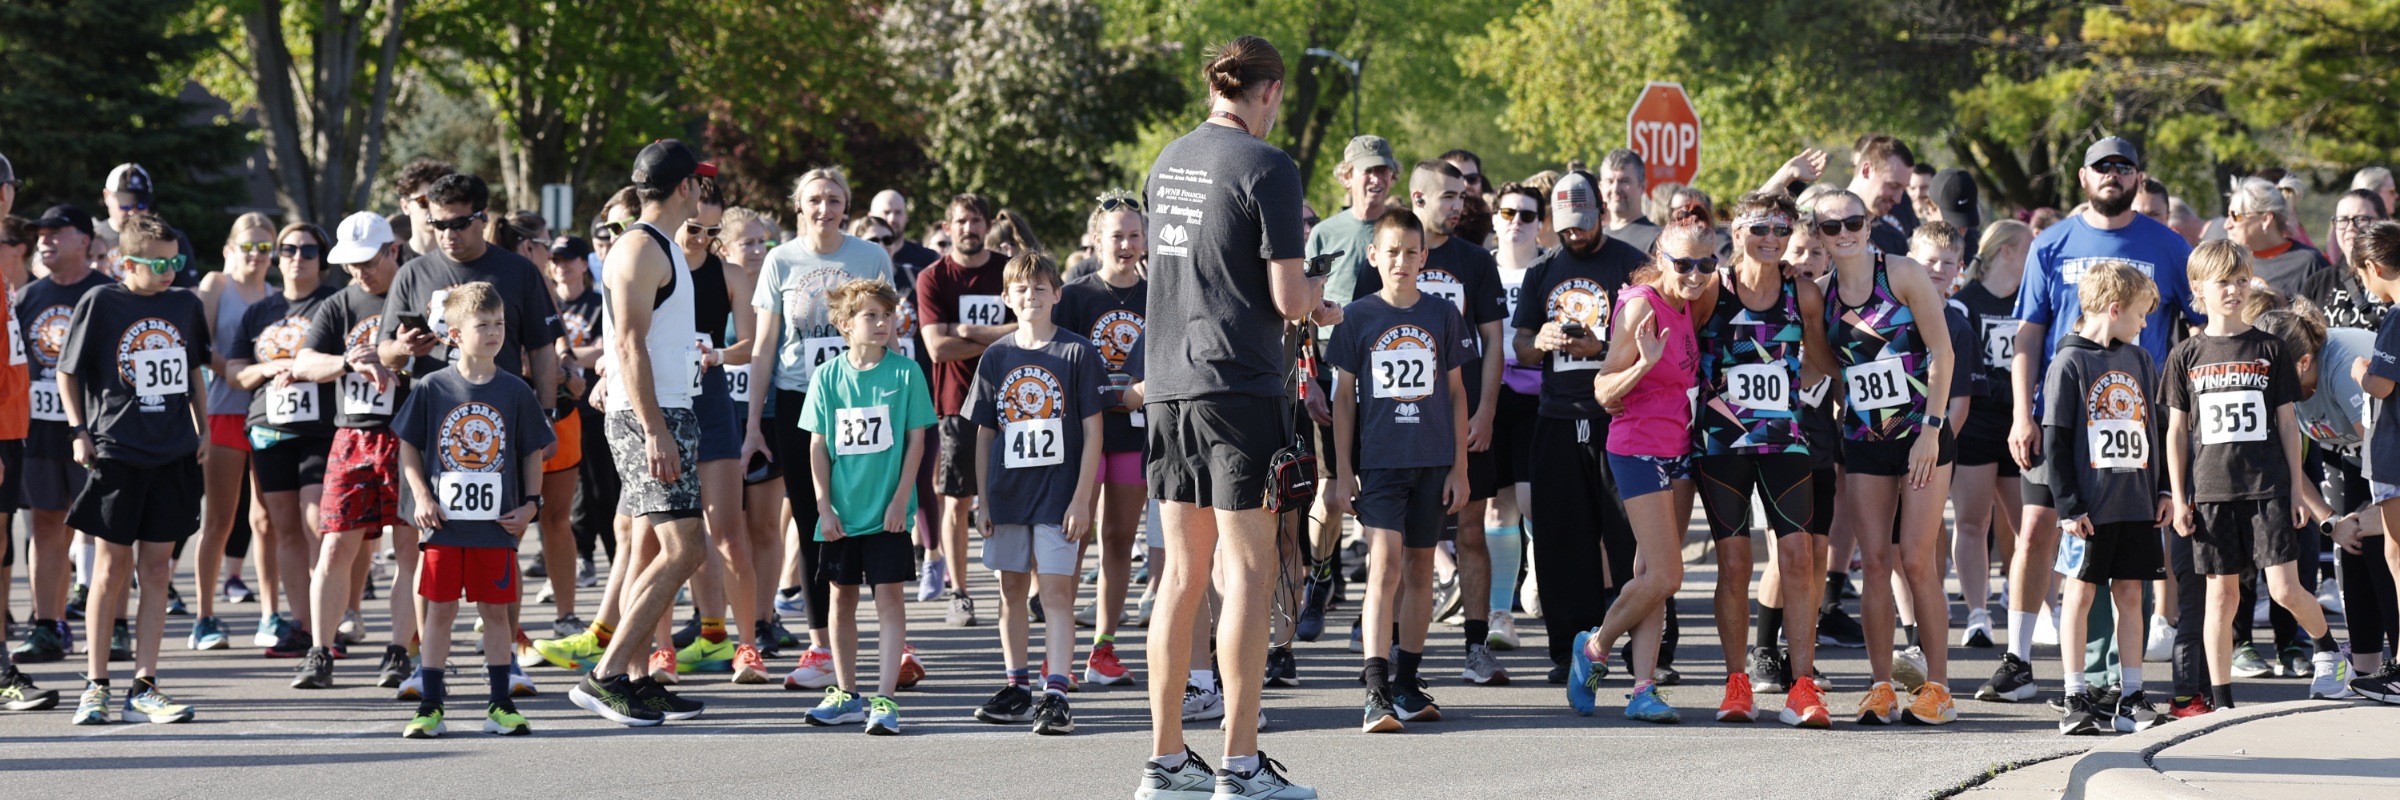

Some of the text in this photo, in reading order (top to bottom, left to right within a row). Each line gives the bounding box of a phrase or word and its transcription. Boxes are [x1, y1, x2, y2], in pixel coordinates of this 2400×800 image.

[1635, 121, 1696, 167] STOP
[1185, 169, 1208, 178] Supporting
[1165, 187, 1181, 196] WNB
[1170, 205, 1204, 218] Merchants
[967, 303, 1000, 325] 442
[1548, 282, 1572, 319] DONUT
[1574, 280, 1604, 302] DASH
[119, 320, 181, 361] DONUT DASH
[1092, 313, 1117, 347] DONUT
[1401, 327, 1435, 351] DASH
[145, 358, 183, 388] 362
[1381, 359, 1426, 389] 322
[1737, 373, 1781, 401] 380
[1854, 369, 1899, 402] 381
[2111, 373, 2140, 398] DASH
[2188, 363, 2269, 382] WINONA
[2194, 372, 2269, 392] WINHAWKS
[276, 391, 311, 415] 254
[350, 381, 385, 407] 312
[997, 368, 1022, 411] DONUT
[1024, 367, 1058, 391] DASH
[440, 405, 469, 447] DONUT
[471, 404, 503, 431] DASH
[841, 417, 882, 446] 327
[2208, 402, 2258, 434] 355
[1013, 429, 1056, 459] 412
[2100, 429, 2143, 459] 299
[450, 483, 494, 507] 286
